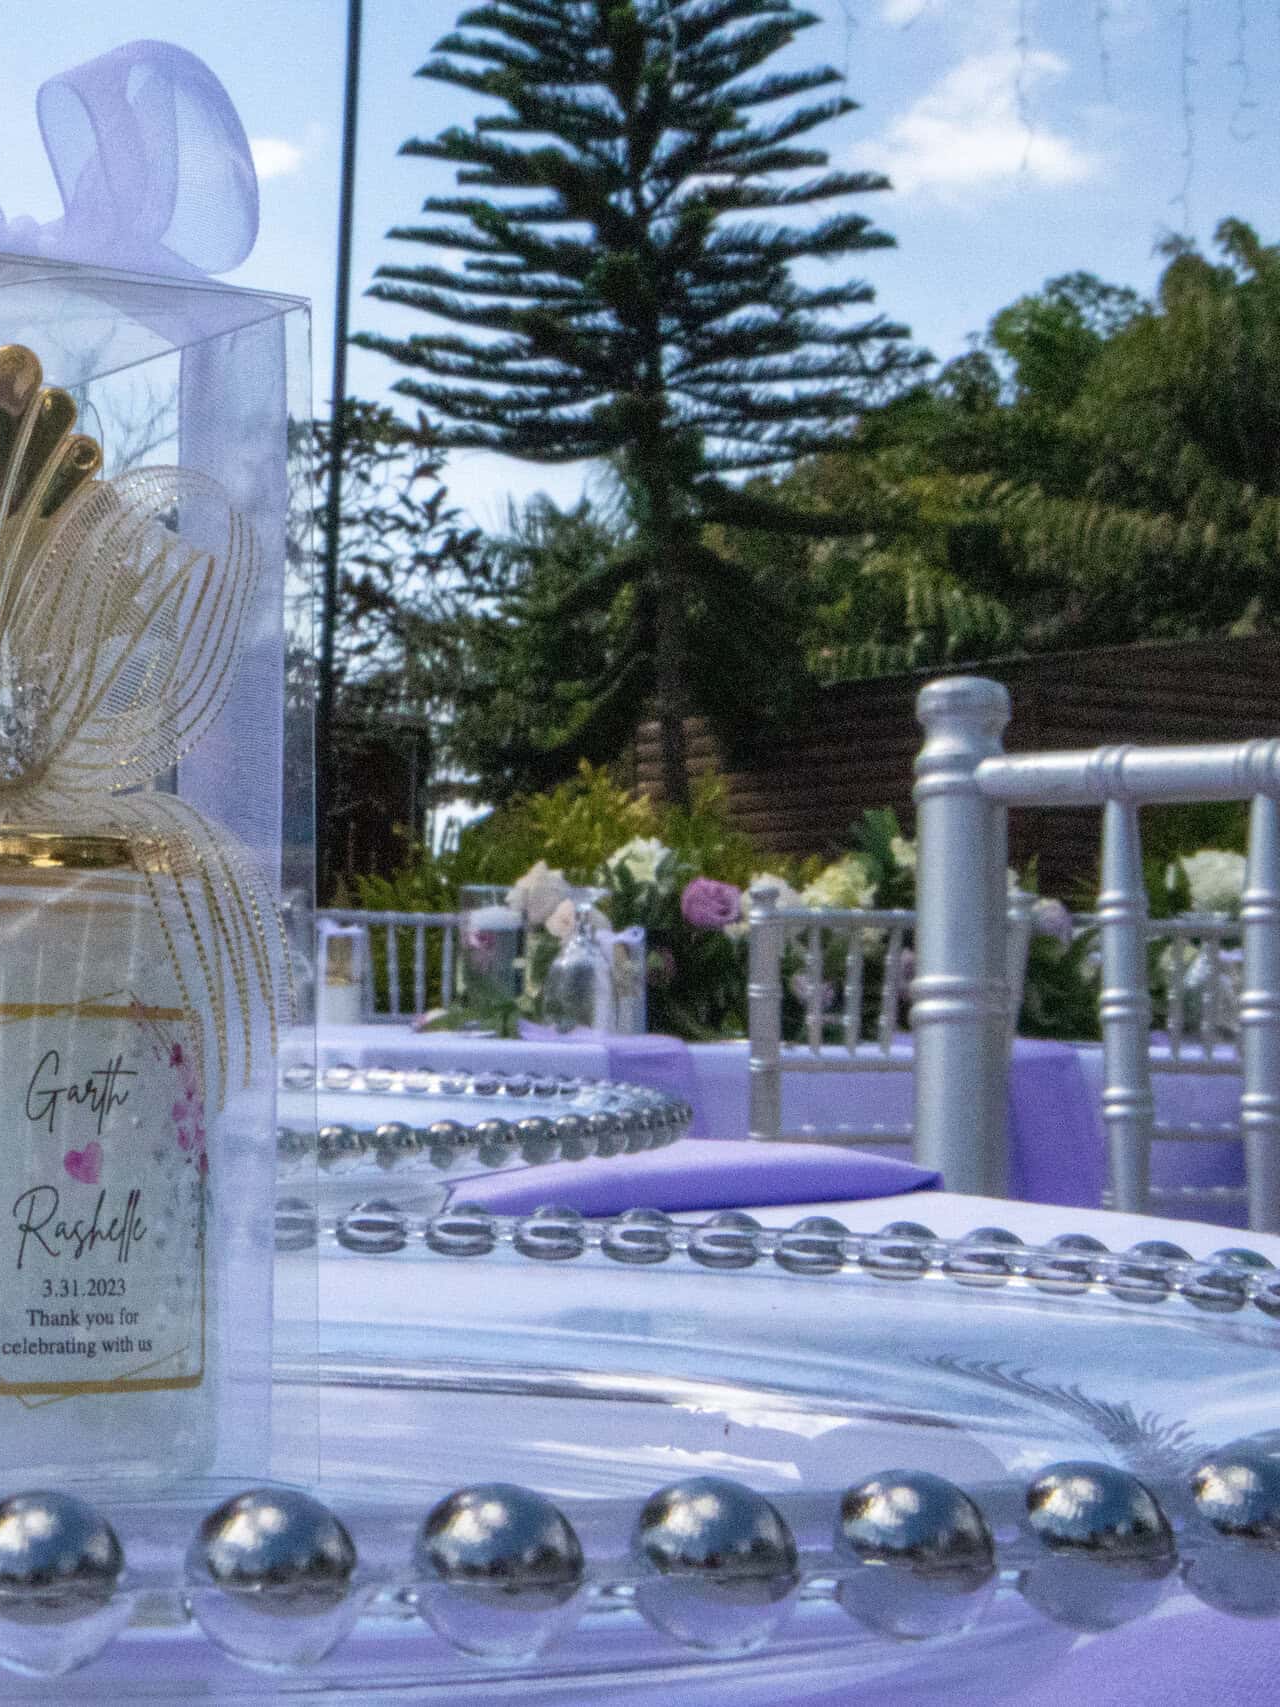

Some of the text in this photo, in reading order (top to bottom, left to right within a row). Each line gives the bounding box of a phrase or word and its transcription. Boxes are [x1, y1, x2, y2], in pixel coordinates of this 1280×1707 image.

[25, 1050, 138, 1135] Garth
[12, 1185, 148, 1269] Rashelle
[42, 1278, 127, 1297] 3.31.2023
[26, 1308, 139, 1331] Thank you for
[2, 1337, 153, 1358] celebrating with us
